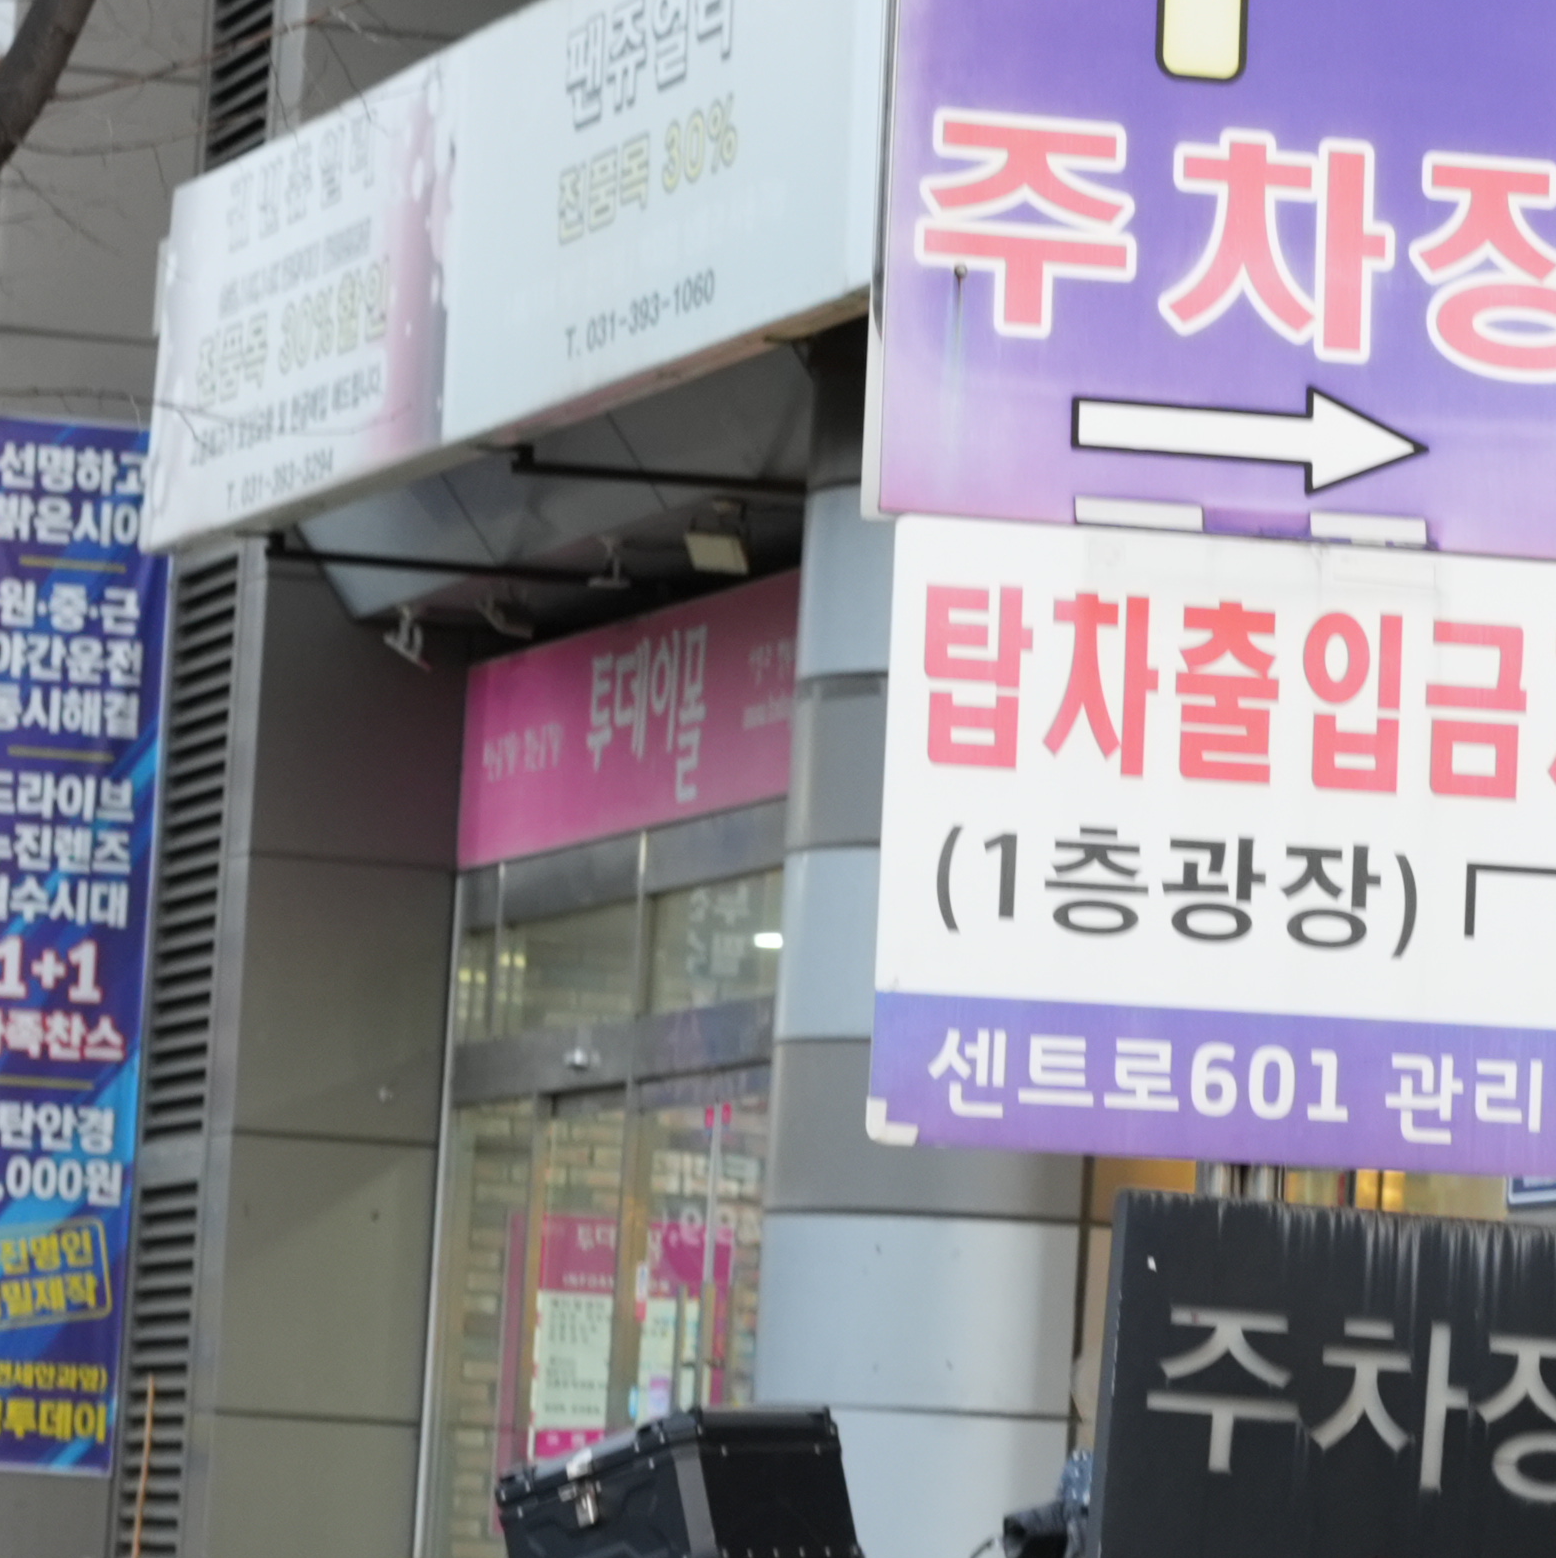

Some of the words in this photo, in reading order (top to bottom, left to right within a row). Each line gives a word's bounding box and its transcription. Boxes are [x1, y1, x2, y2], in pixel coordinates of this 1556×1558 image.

[558, 131, 650, 245] 전품목
[662, 92, 738, 194] 30%
[586, 268, 716, 354] 031-393-1060
[587, 624, 709, 804] 투데이몰
[935, 825, 1418, 958] (1층광장)
[928, 1027, 1348, 1122] 센트로601
